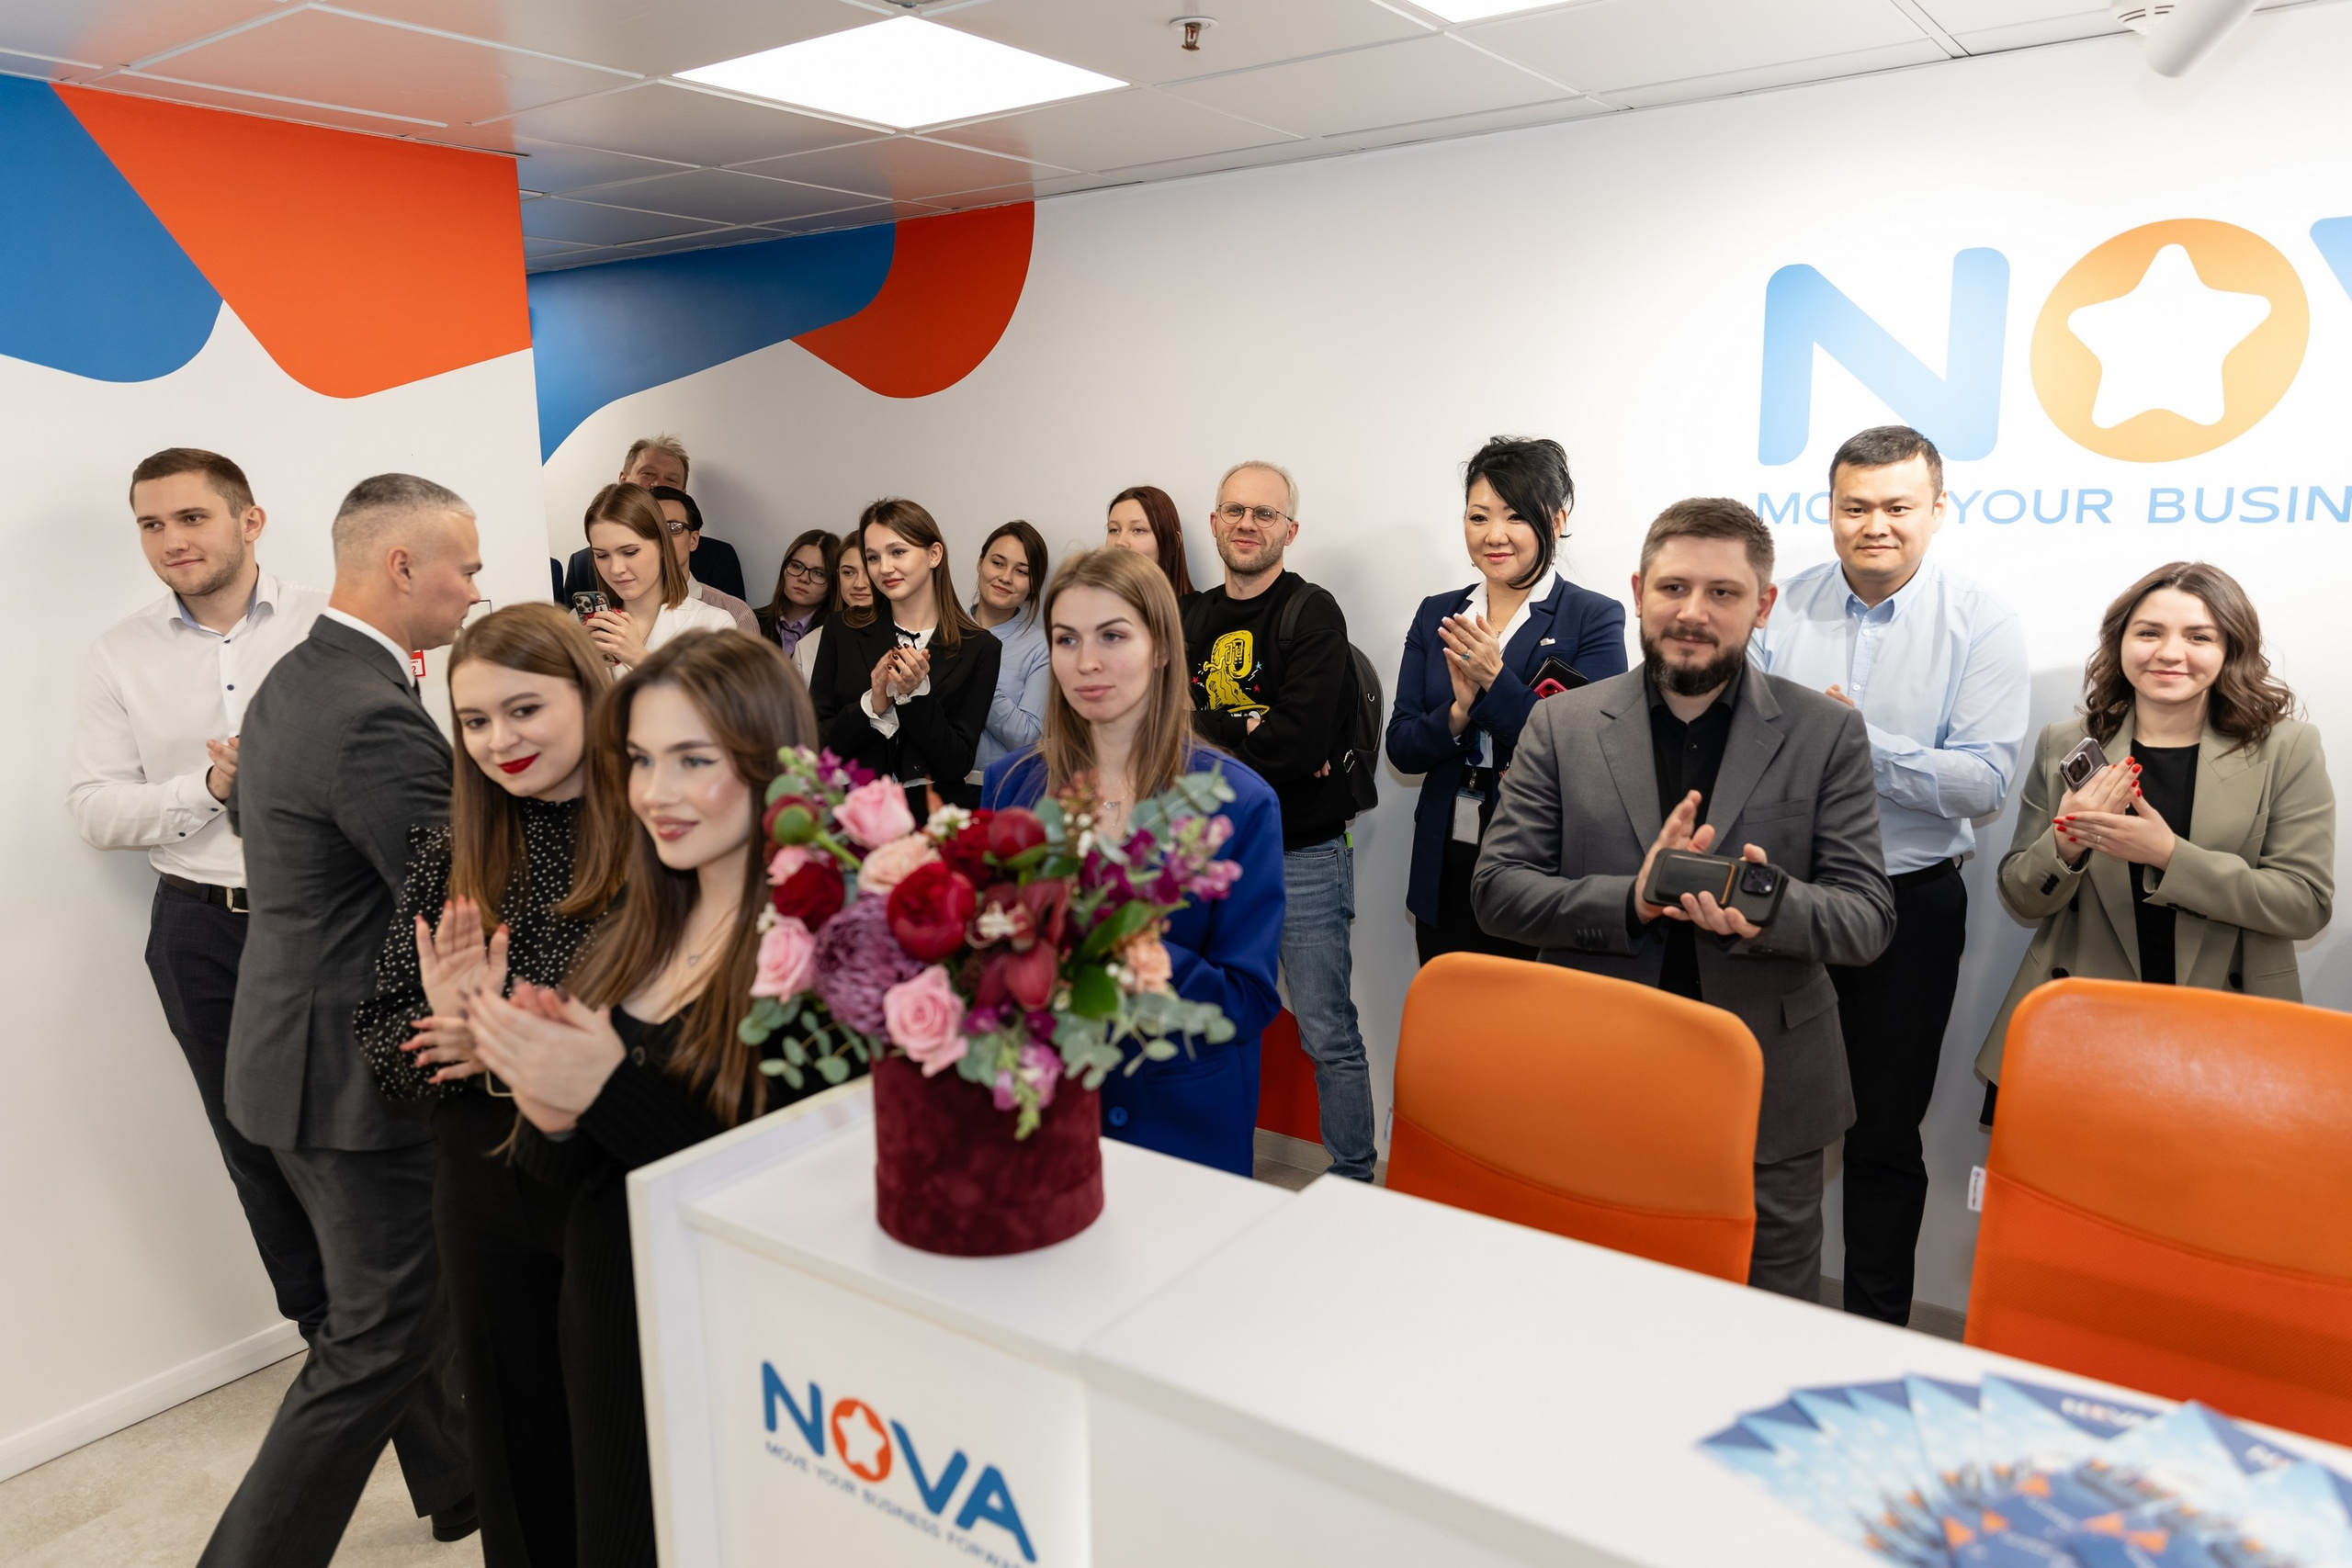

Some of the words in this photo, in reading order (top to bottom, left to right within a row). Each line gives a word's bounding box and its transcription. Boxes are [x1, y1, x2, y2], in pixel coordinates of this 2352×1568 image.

[1758, 216, 2352, 466] NO
[1757, 492, 1829, 525] MO
[1948, 489, 2113, 525] YOUR
[762, 1359, 1036, 1563] NOVA
